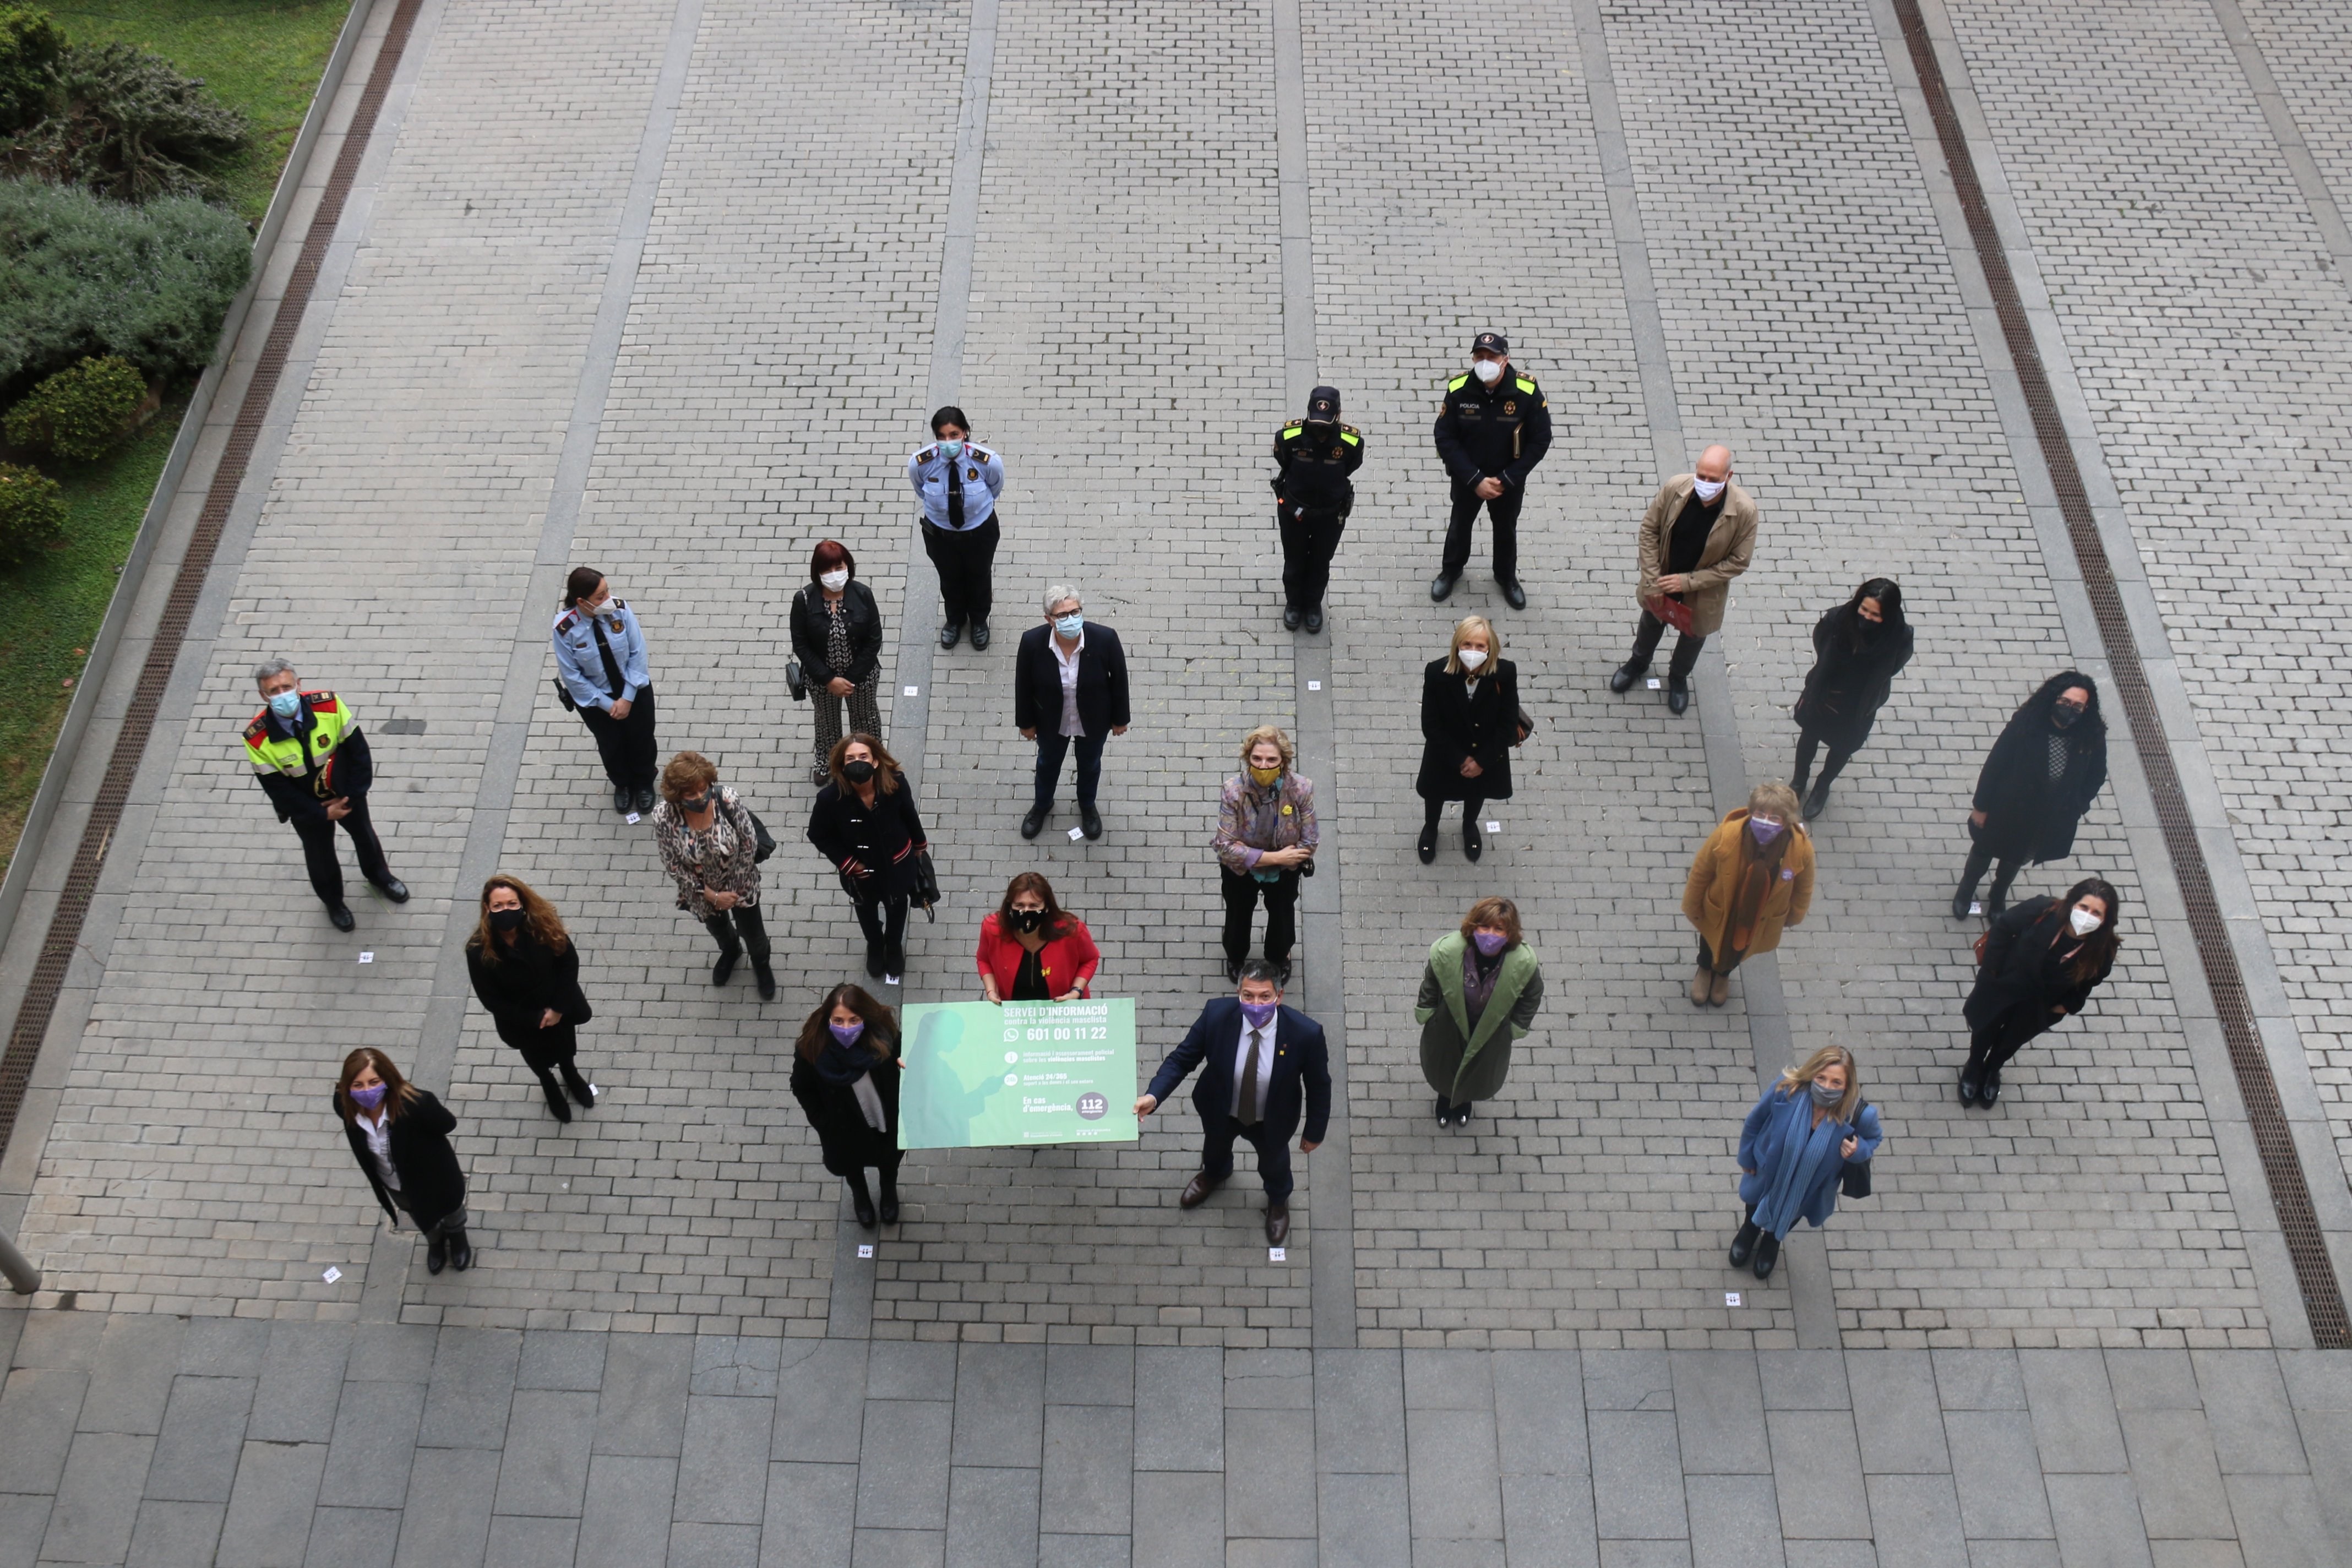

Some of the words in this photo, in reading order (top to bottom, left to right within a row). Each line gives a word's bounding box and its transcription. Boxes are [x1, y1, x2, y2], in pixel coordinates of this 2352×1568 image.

[1004, 1008, 1036, 1017] SERVEI
[1039, 1003, 1108, 1016] D'INFORMACIÓ
[1027, 1028, 1049, 1041] 601
[1054, 1027, 1070, 1040] 00
[1074, 1027, 1086, 1039] 11
[1091, 1026, 1107, 1039] 22
[1023, 1103, 1073, 1113] d'emergència,
[1081, 1099, 1103, 1110] 112
